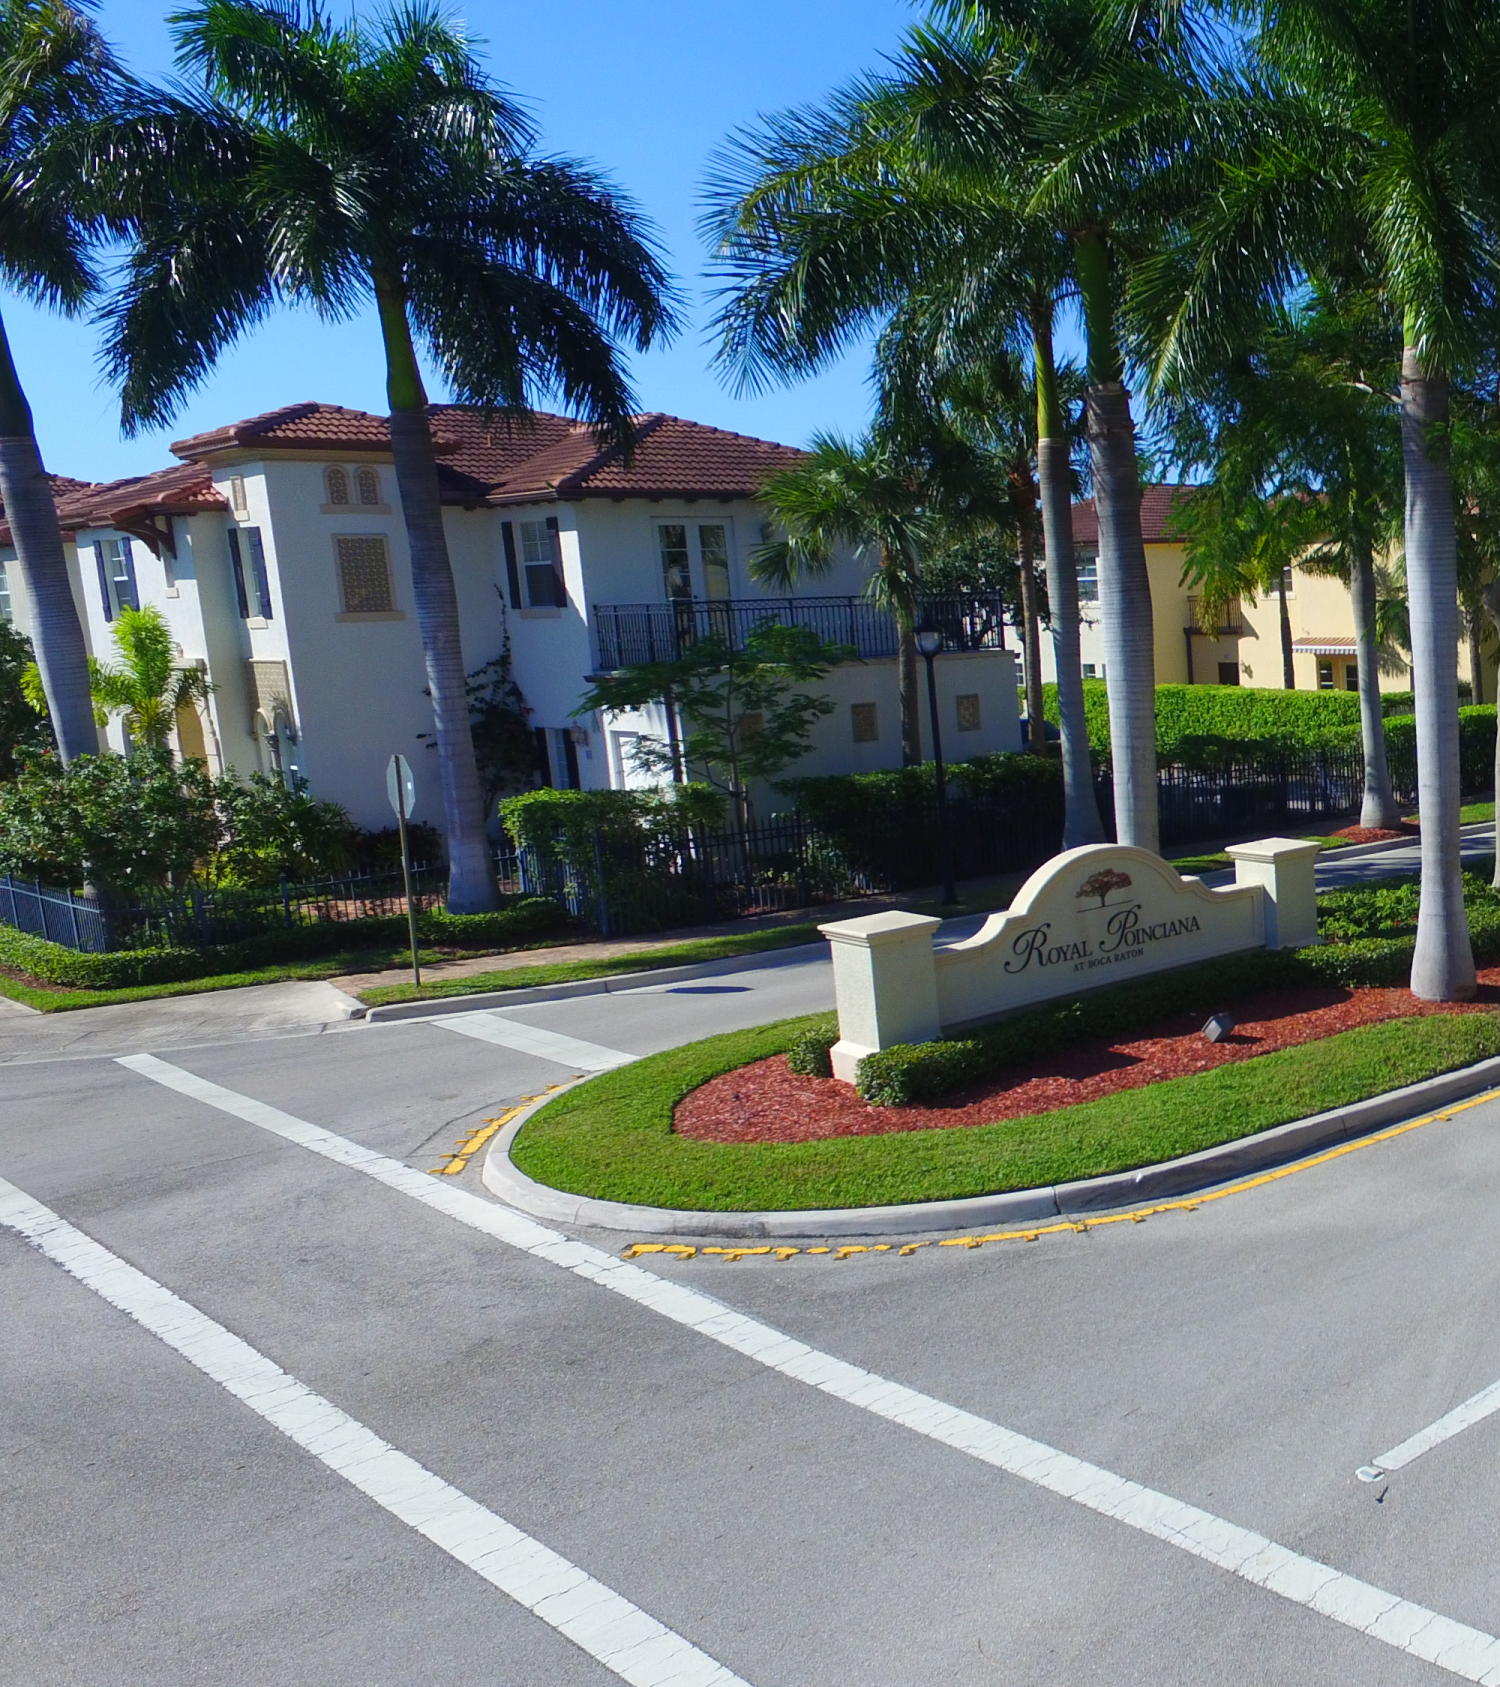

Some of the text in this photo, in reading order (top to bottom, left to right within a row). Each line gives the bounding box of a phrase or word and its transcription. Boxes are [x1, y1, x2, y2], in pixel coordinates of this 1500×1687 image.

[1003, 904, 1201, 974] ROYAL POINCIANA
[1073, 947, 1144, 972] AT BOCA RATON
